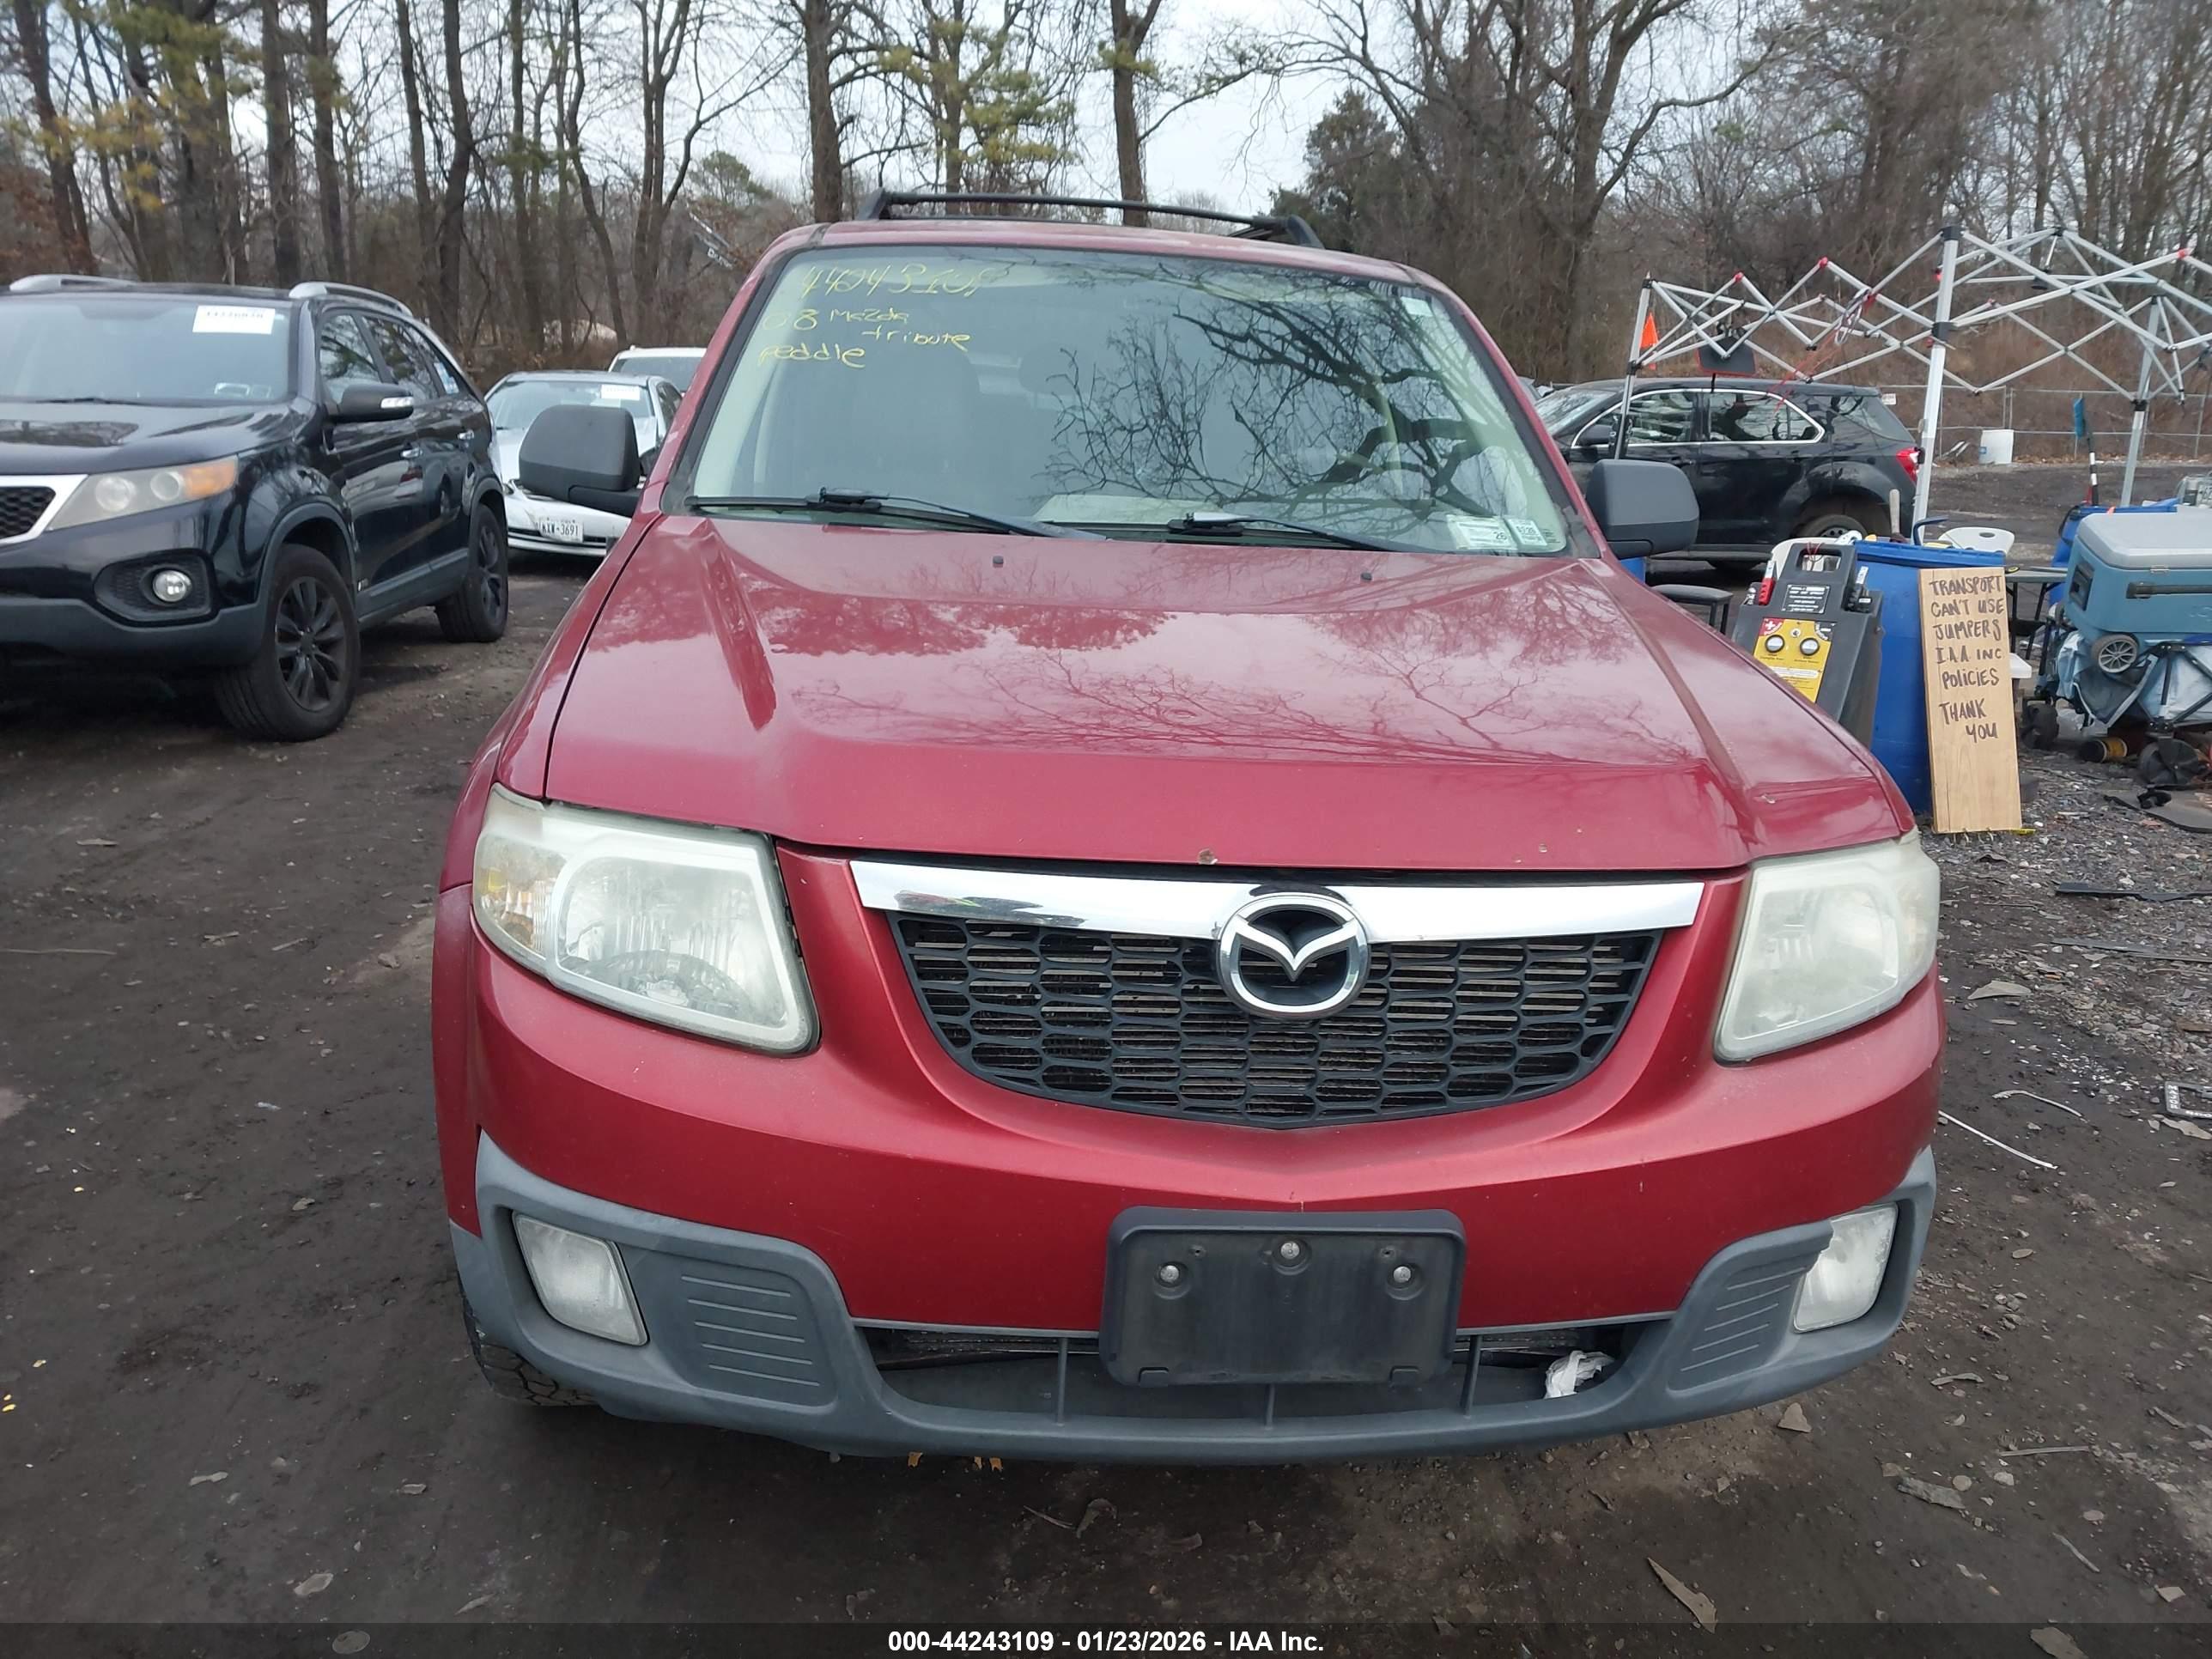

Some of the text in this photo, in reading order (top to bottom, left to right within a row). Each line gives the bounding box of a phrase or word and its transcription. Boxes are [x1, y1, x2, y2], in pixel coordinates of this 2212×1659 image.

[1929, 574, 2002, 596] TRANSPORT
[1930, 598, 2004, 617] CAN'T USE
[1932, 619, 2002, 641] JUMPERS
[1938, 698, 1986, 725] THANK
[1966, 722, 1998, 744] YOU
